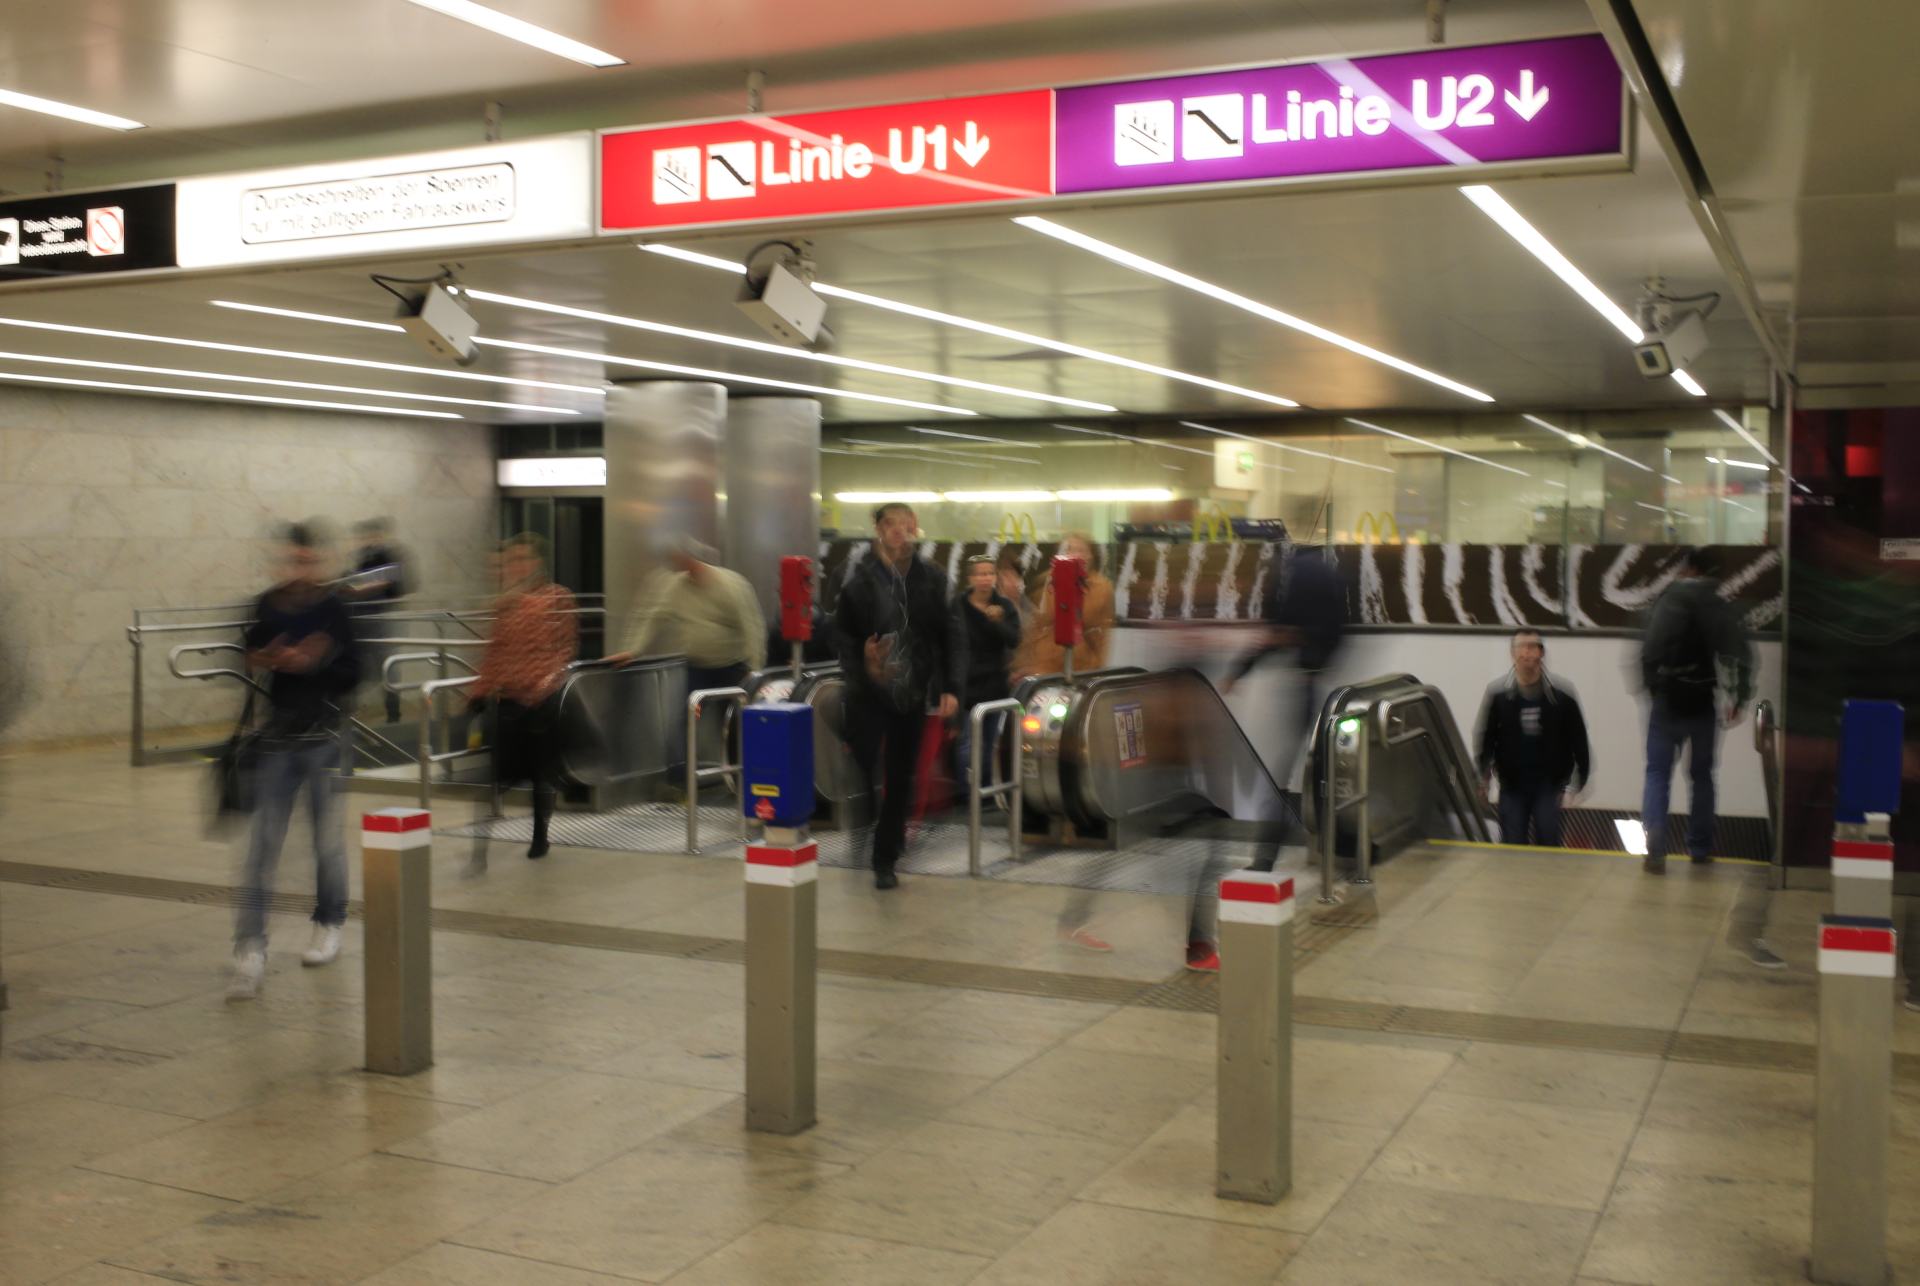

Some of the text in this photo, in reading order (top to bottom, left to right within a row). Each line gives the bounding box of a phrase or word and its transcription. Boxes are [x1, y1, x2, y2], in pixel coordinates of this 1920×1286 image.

[1252, 74, 1495, 144] Linie U2
[761, 124, 947, 186] Linie U1
